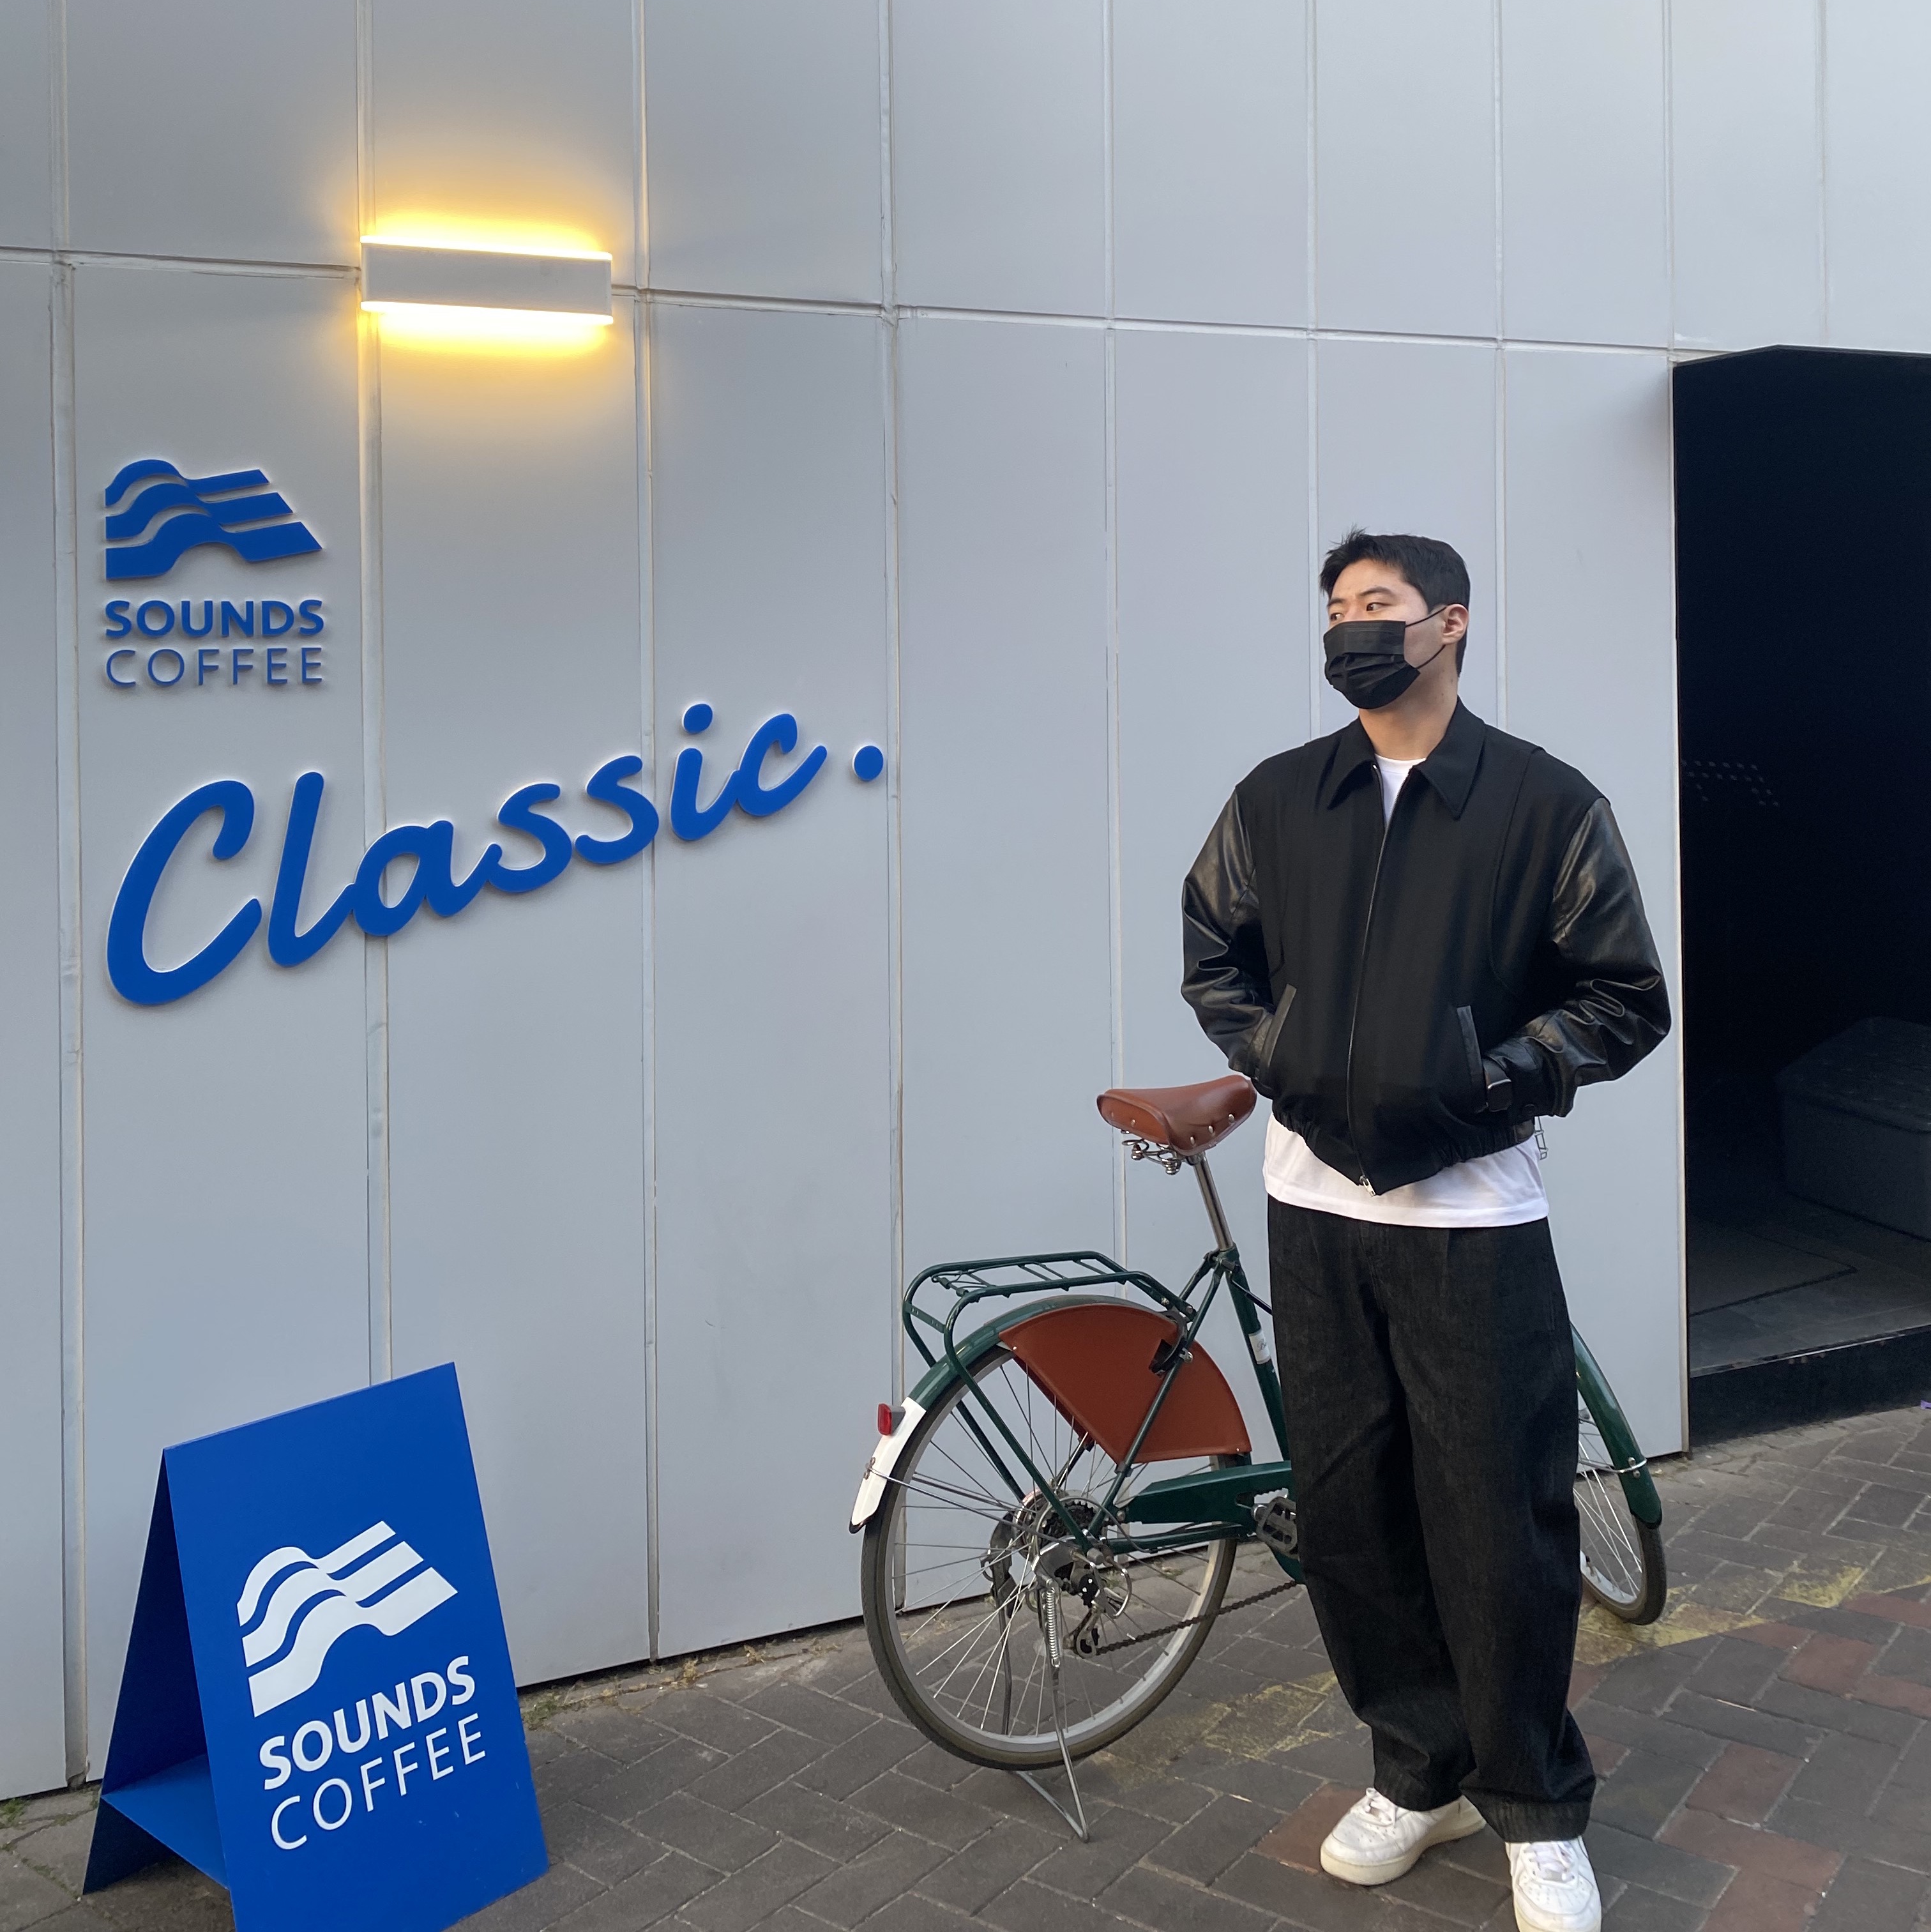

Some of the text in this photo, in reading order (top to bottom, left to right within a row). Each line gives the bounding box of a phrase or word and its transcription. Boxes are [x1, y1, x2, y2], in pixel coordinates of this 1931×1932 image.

[105, 599, 325, 639] SOUNDS
[105, 647, 323, 688] COFFEE
[259, 1655, 475, 1790] SOUNDS
[271, 1713, 486, 1850] COFFEE
